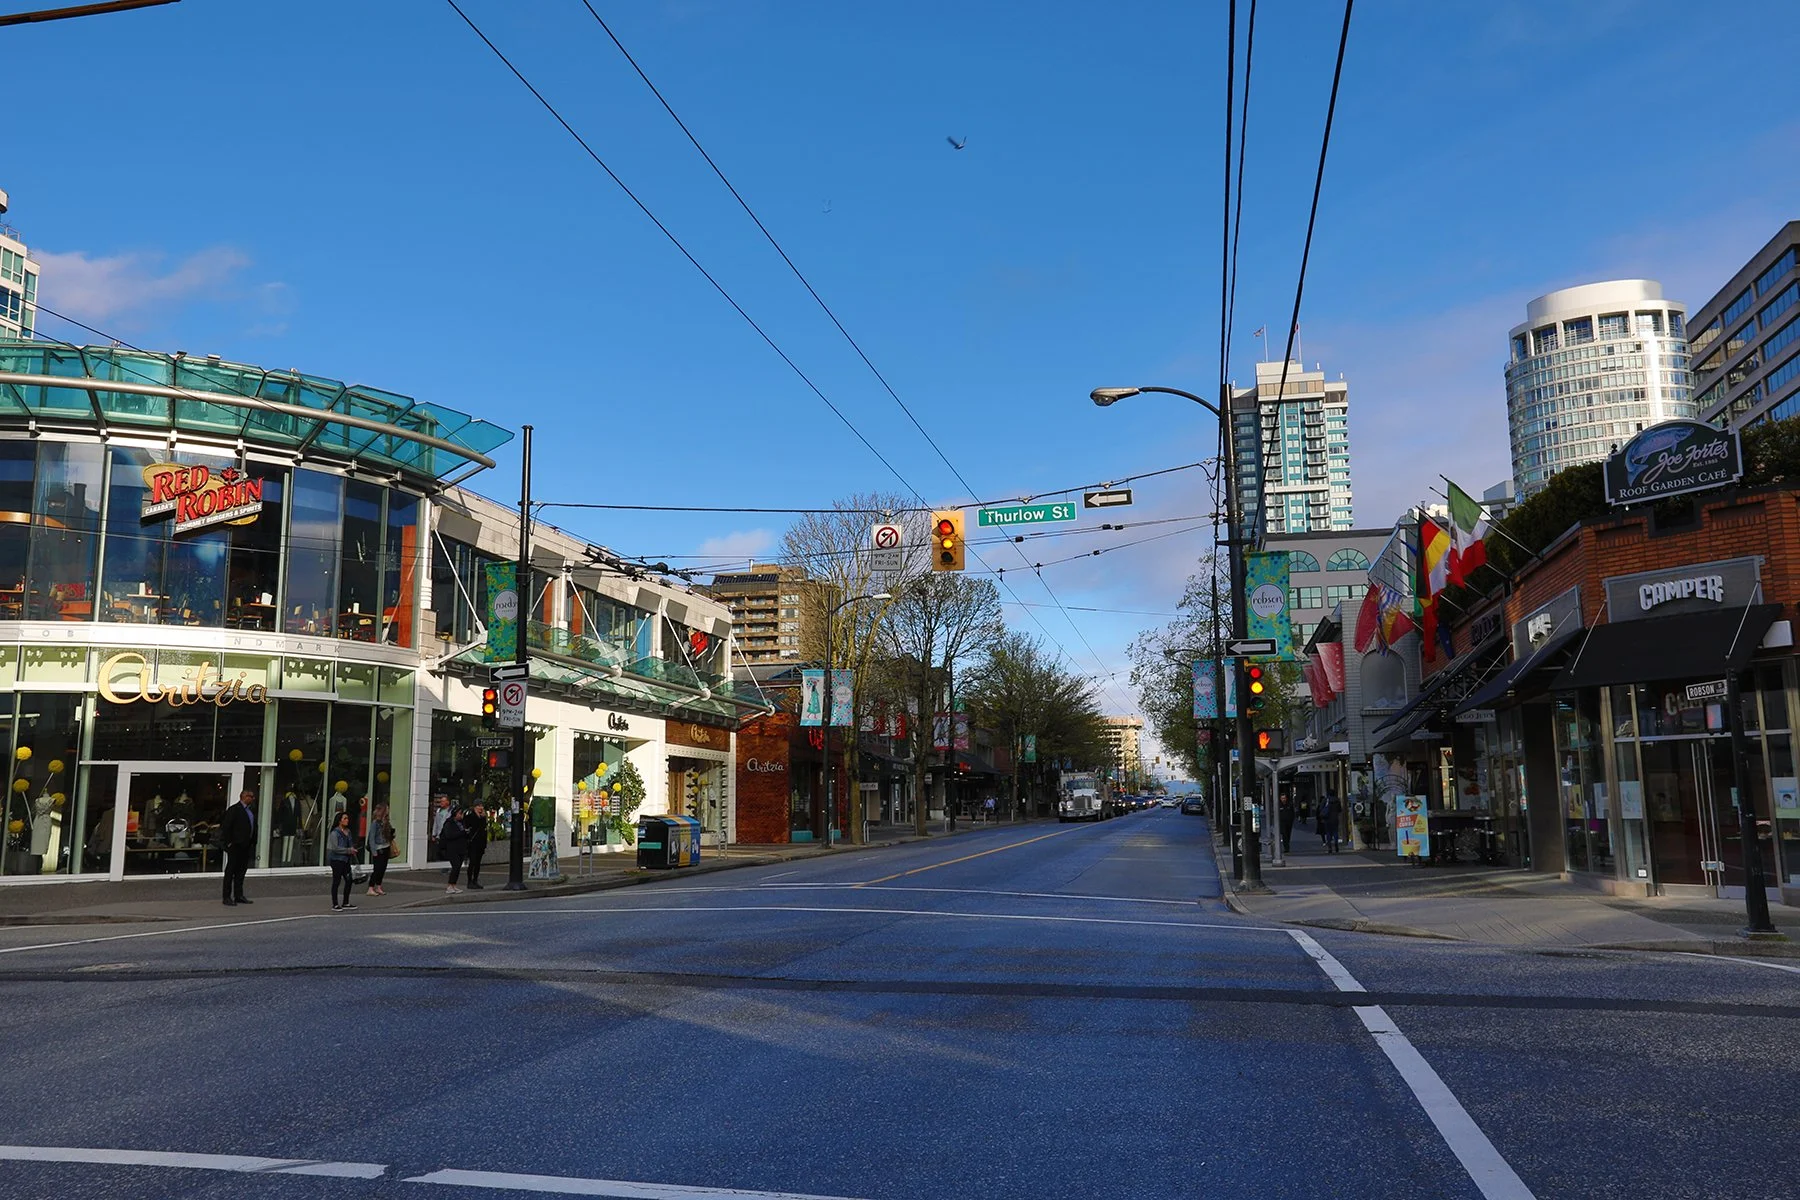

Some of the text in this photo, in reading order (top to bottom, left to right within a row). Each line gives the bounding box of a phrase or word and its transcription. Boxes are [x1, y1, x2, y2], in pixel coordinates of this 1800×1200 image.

[1642, 438, 1729, 484] Joe Fortes
[151, 465, 209, 505] RED
[1619, 468, 1728, 499] ROOF GARDEN CAFÉ
[144, 502, 175, 515] CANADA'S
[175, 476, 264, 524] ROBIN
[206, 512, 234, 524] BURGERS
[239, 505, 262, 515] SPIRITS
[985, 506, 1069, 524] Thurlow St
[1252, 592, 1283, 606] robson
[1639, 575, 1724, 610] CAMPER
[98, 651, 273, 708] Aritzia
[1690, 684, 1715, 697] ROBSON
[746, 757, 785, 773] Aritzia
